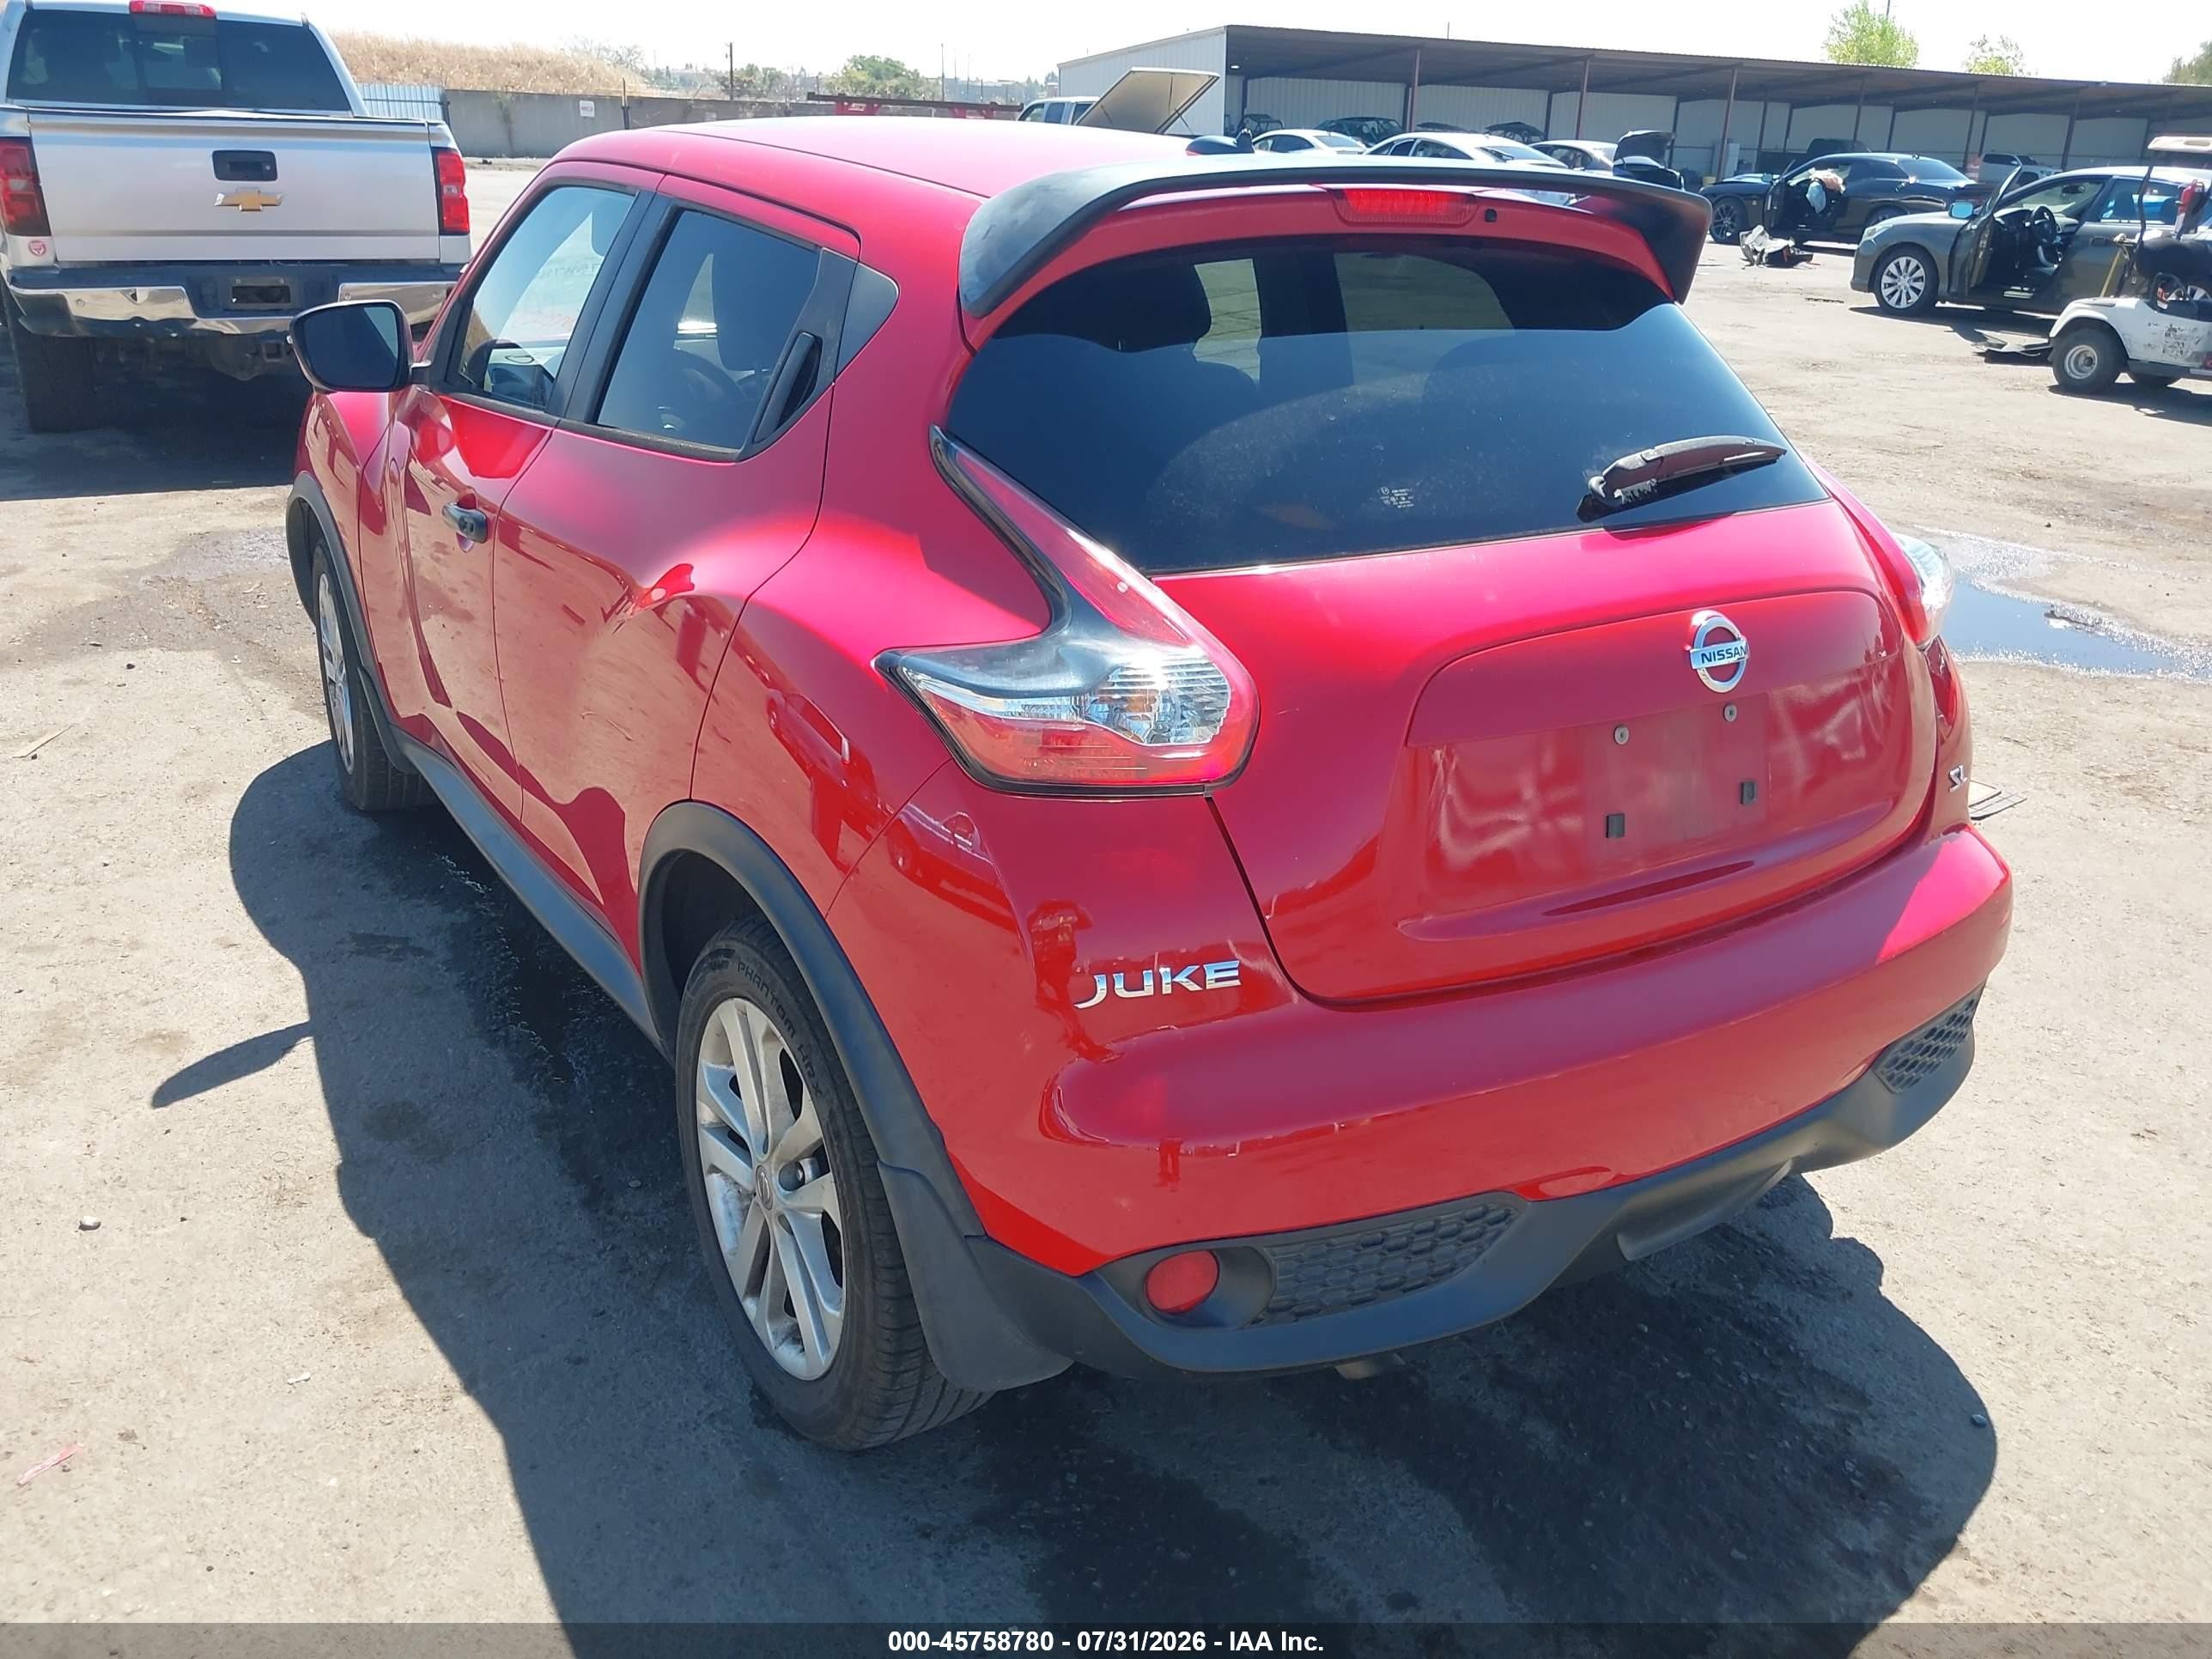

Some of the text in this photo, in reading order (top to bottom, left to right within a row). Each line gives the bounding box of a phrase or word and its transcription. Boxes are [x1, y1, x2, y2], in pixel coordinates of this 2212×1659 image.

[1701, 645, 1747, 663] NISSAN
[738, 961, 797, 1038] PHANTOM
[1073, 960, 1242, 1009] JUKE
